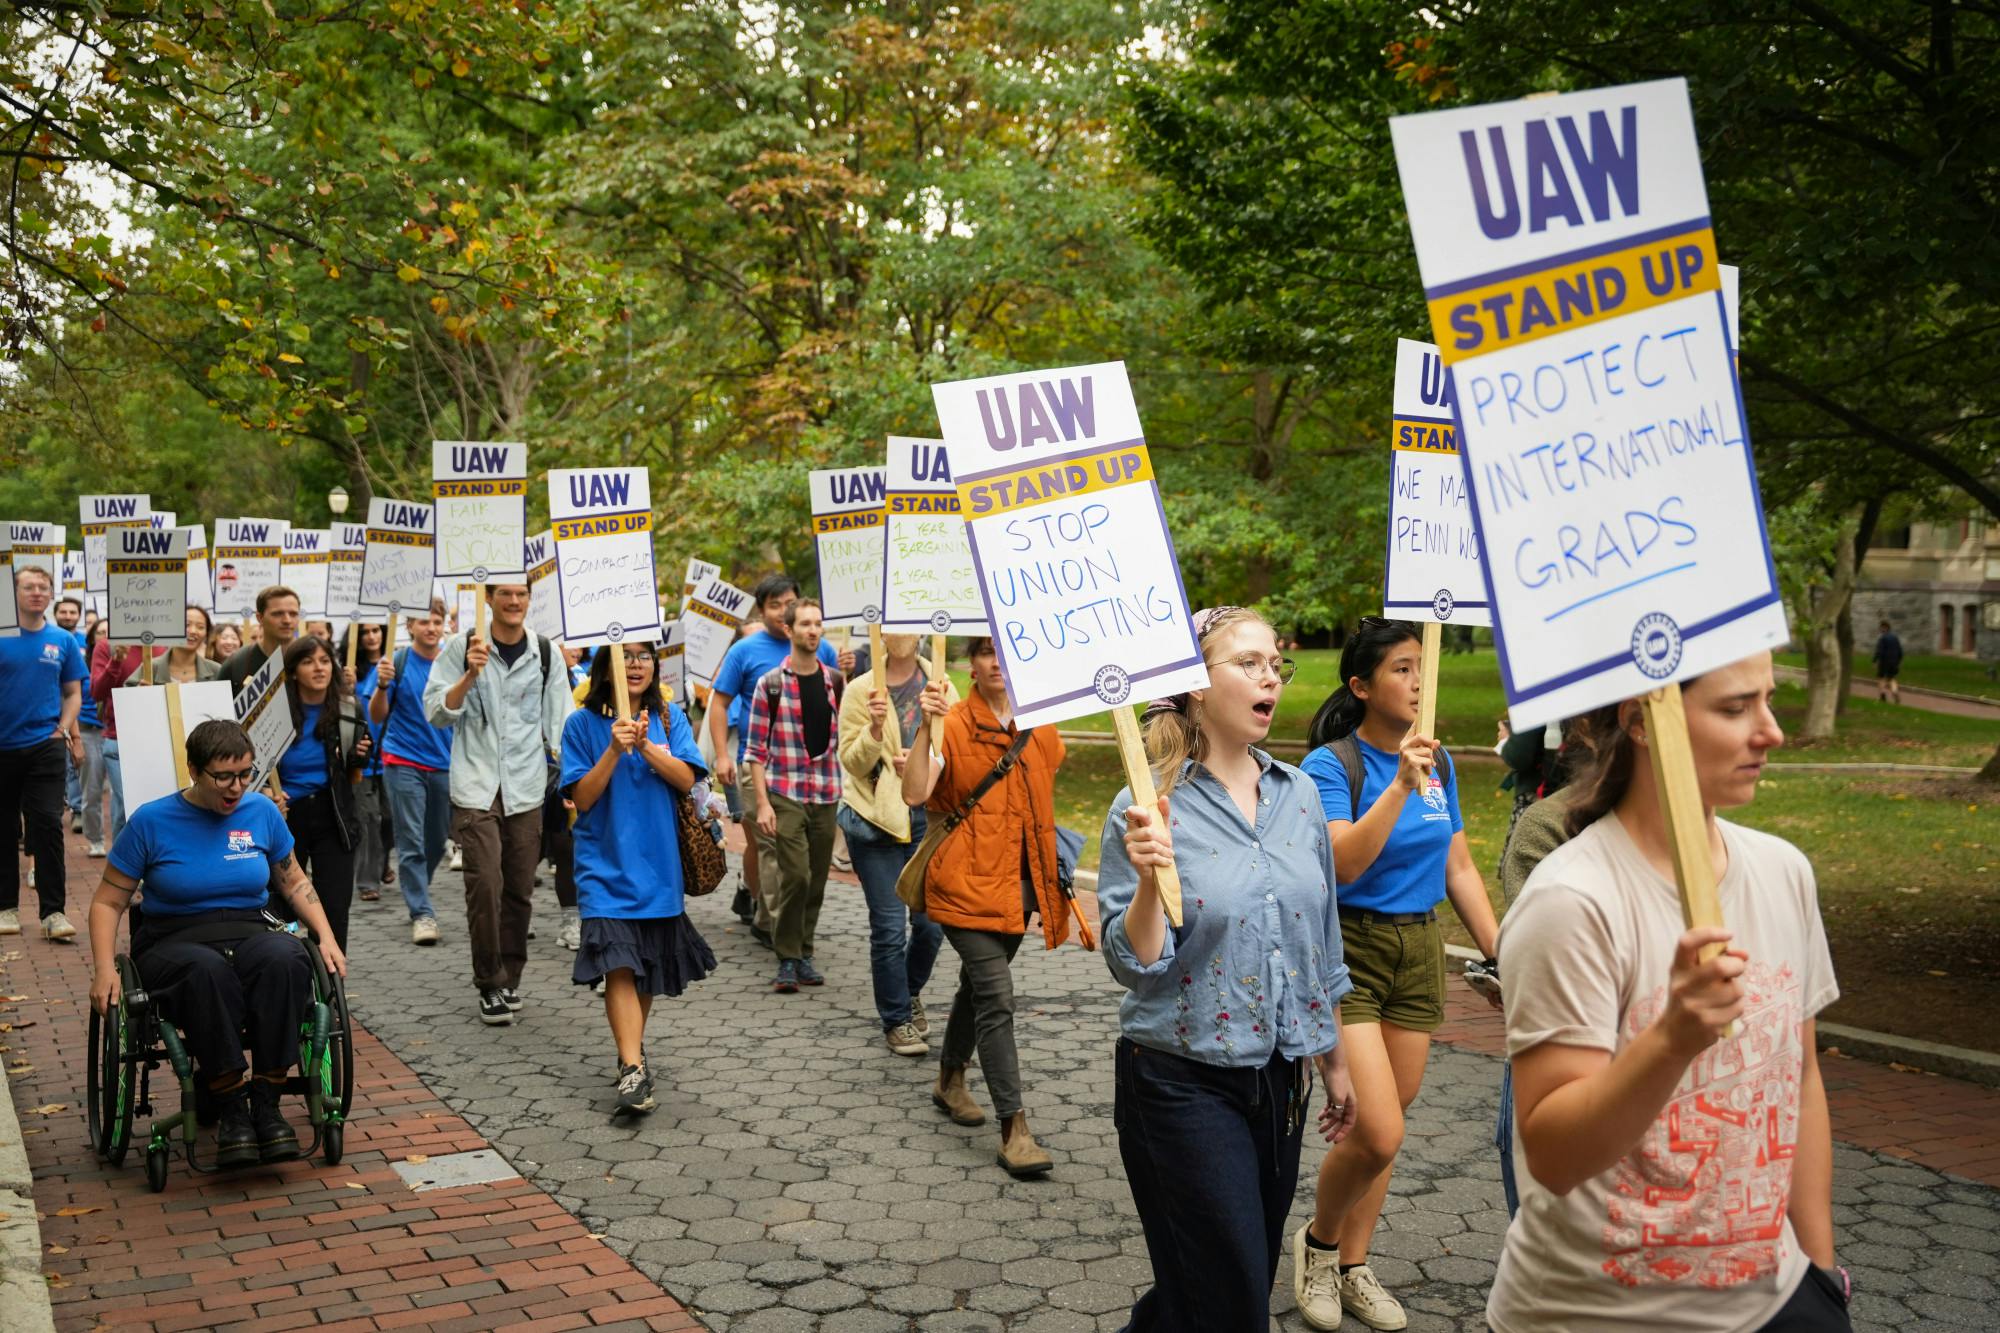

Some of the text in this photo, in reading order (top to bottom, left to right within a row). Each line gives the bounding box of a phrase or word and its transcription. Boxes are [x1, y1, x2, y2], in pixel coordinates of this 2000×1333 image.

[1459, 105, 1640, 241] UAW
[1449, 244, 1704, 351] STAND UP
[1471, 327, 1697, 427] PROTECT
[975, 375, 1096, 452] UAW
[1399, 425, 1458, 451] STAN
[453, 446, 509, 474] UAW
[911, 445, 951, 483] UA
[1484, 400, 1743, 514] INTERNATIONAL
[438, 482, 522, 496] STAND UP
[569, 474, 630, 508] UAW
[830, 471, 886, 504] UAW
[969, 453, 1141, 513] STAND UP
[1397, 465, 1468, 508] WE MA
[93, 498, 136, 518] UAW
[383, 503, 430, 528] UAW
[892, 497, 960, 512] STAND
[10, 524, 44, 542] UAW
[228, 522, 269, 543] UAW
[440, 523, 520, 537] CONTRACT
[558, 516, 647, 538] STAND UP
[819, 513, 878, 531] STAND
[917, 522, 948, 536] YEAR
[1006, 504, 1110, 551] STOP
[122, 530, 172, 555] UAW
[284, 532, 319, 550] UAW
[343, 527, 366, 546] UA
[370, 531, 414, 545] STAND
[821, 538, 862, 560] PENN
[1397, 516, 1480, 561] PENN WO
[1514, 496, 1698, 589] GRADS
[218, 549, 258, 558] STAND
[332, 552, 362, 562] STAN
[898, 541, 972, 559] BARGAININ
[111, 562, 184, 573] STAND UP
[908, 570, 938, 583] YEAR
[951, 568, 973, 581] OF
[993, 550, 1120, 607] UNION
[127, 576, 157, 592] FOR
[707, 581, 745, 612] UAW
[1005, 585, 1175, 662] BUSTING
[234, 663, 271, 720] UAW
